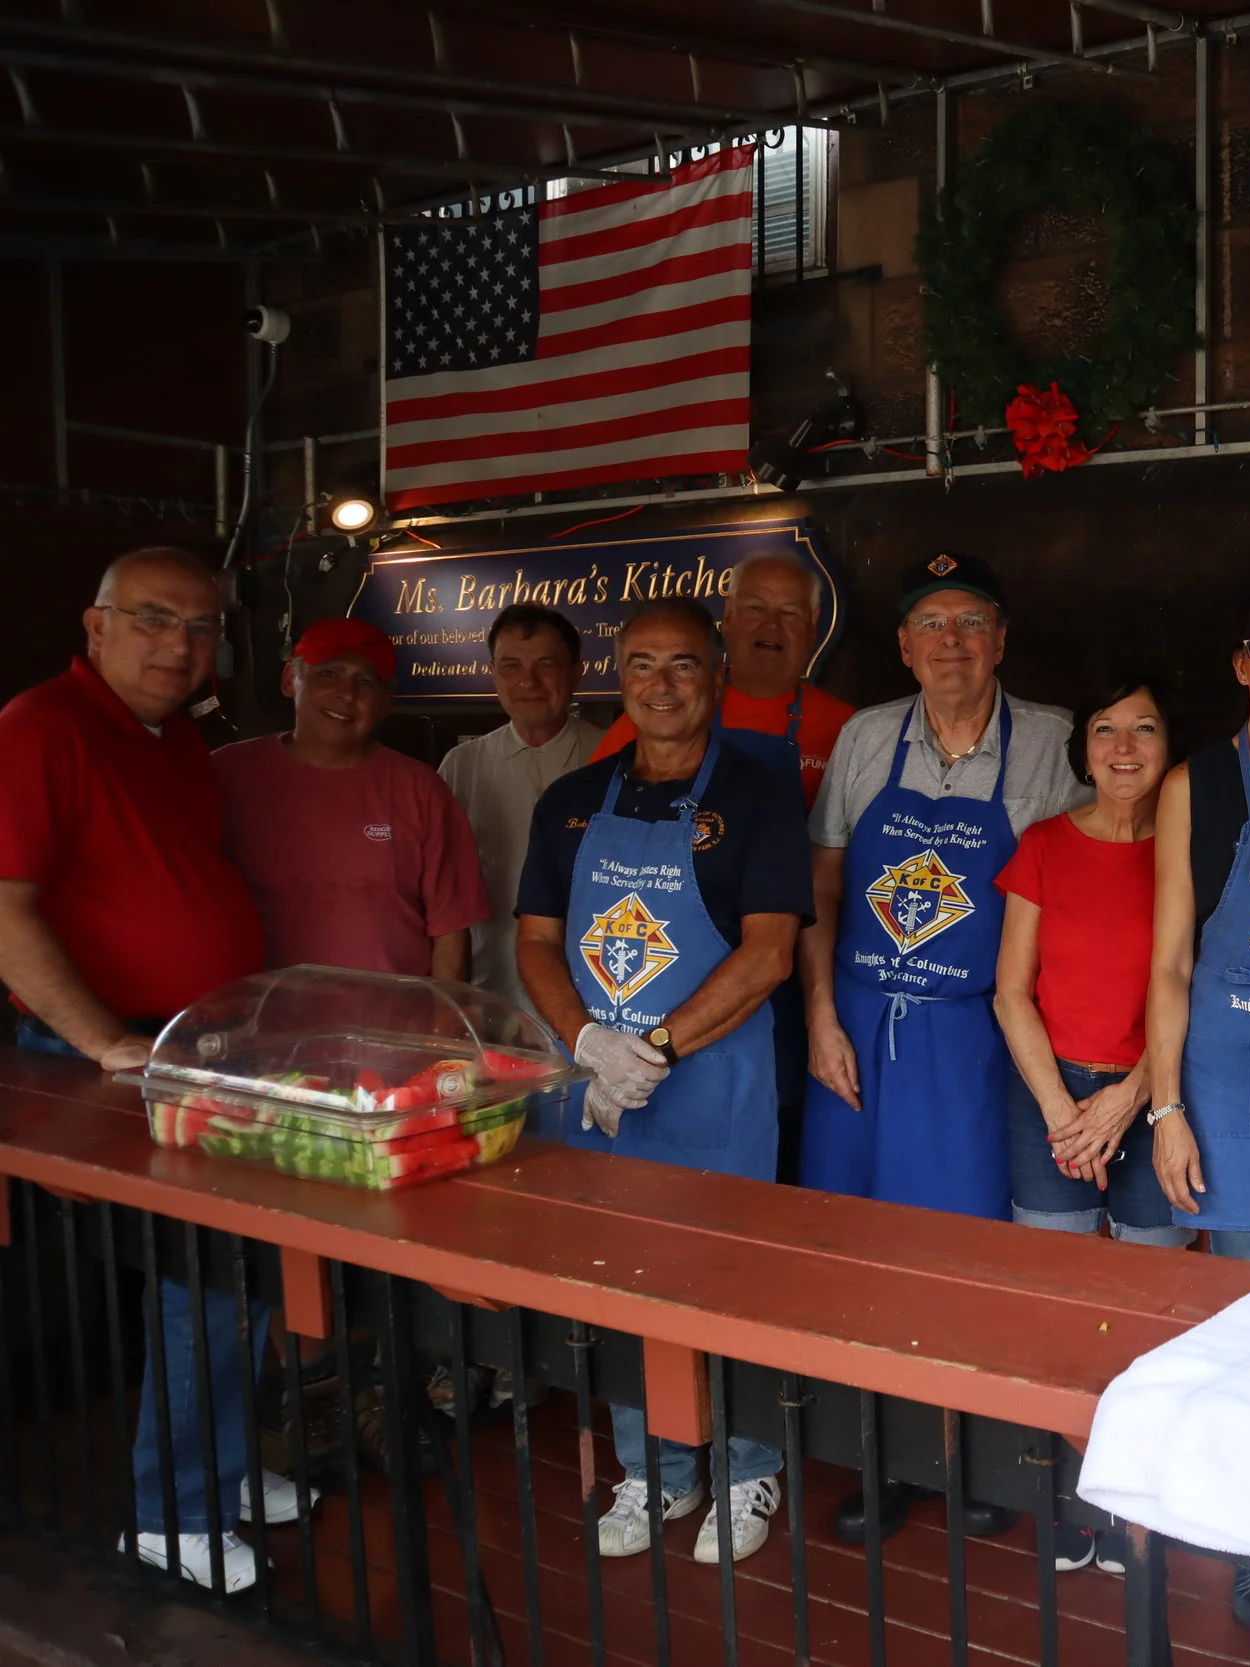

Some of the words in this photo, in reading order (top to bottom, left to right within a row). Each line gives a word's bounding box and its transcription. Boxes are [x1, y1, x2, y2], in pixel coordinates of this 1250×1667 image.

[394, 577, 444, 615] Ms.
[454, 563, 609, 611] Barbara's
[619, 555, 735, 602] Kitche
[406, 629, 420, 646] of
[420, 632, 438, 645] our
[442, 629, 486, 645] beloved
[596, 622, 624, 638] Tire
[411, 661, 477, 677] Dedicated
[594, 655, 612, 676] of
[882, 824, 903, 836] When
[904, 828, 934, 845] Served
[901, 815, 931, 833] Always
[956, 822, 982, 835] Right
[607, 860, 638, 877] Always
[659, 864, 681, 878] Right
[647, 880, 652, 888] a
[899, 873, 909, 885] K
[912, 877, 925, 886] OF
[929, 878, 941, 889] C
[604, 917, 614, 933] K
[618, 924, 632, 934] OF
[636, 922, 648, 937] C
[906, 956, 969, 978] Columbus
[622, 1007, 666, 1026] Colum
